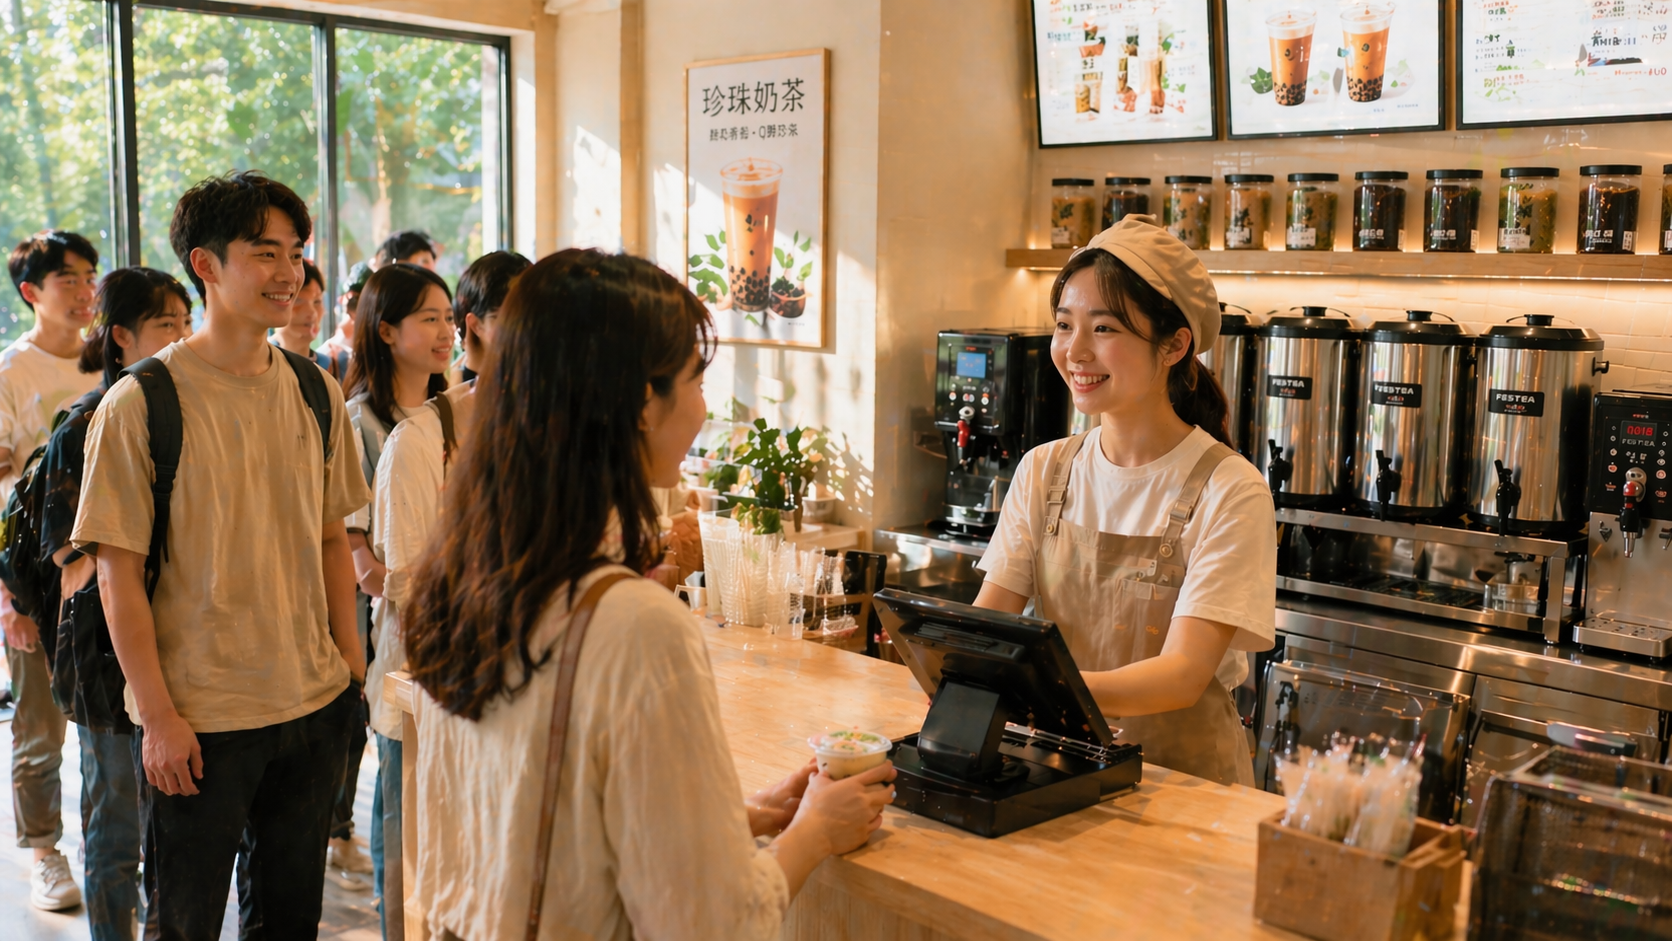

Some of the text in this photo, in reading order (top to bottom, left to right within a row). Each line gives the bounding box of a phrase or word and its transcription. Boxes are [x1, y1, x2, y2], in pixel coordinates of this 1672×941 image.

[702, 78, 805, 117] 珍珠奶茶
[1496, 393, 1535, 403] FESTEA
